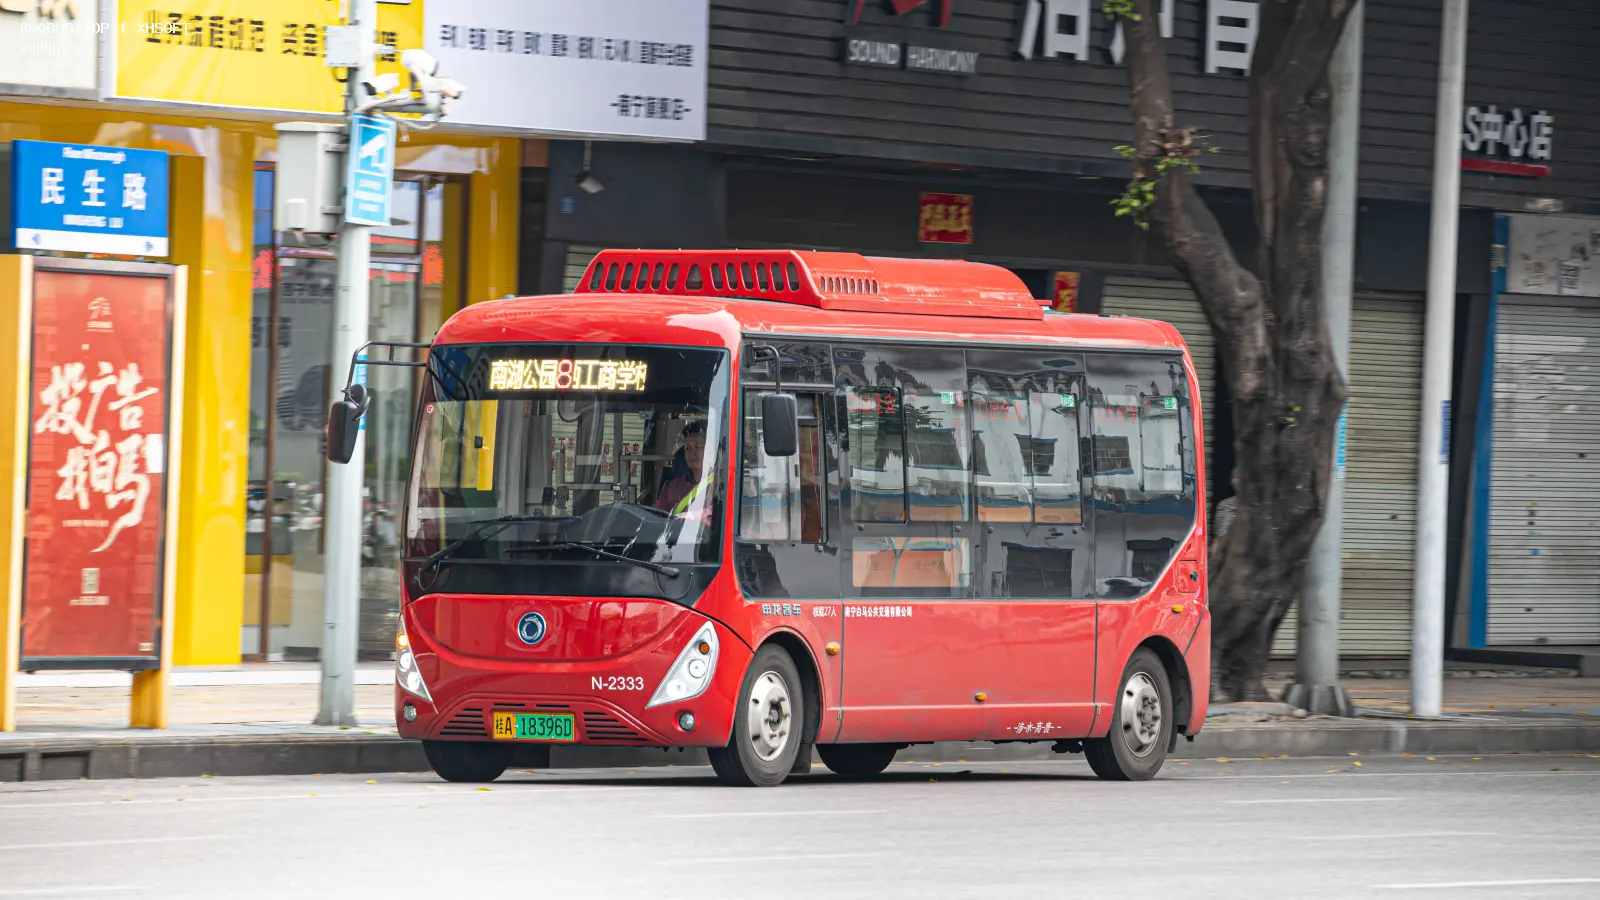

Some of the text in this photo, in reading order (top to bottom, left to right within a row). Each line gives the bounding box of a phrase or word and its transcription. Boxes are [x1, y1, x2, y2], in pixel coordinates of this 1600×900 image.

[848, 39, 979, 73] SOUND HARMONY
[1461, 105, 1554, 160] S中心店
[40, 167, 147, 211] 民生路
[845, 605, 913, 618] 南宁白马公共交通有限公司
[591, 676, 645, 691] N-2333
